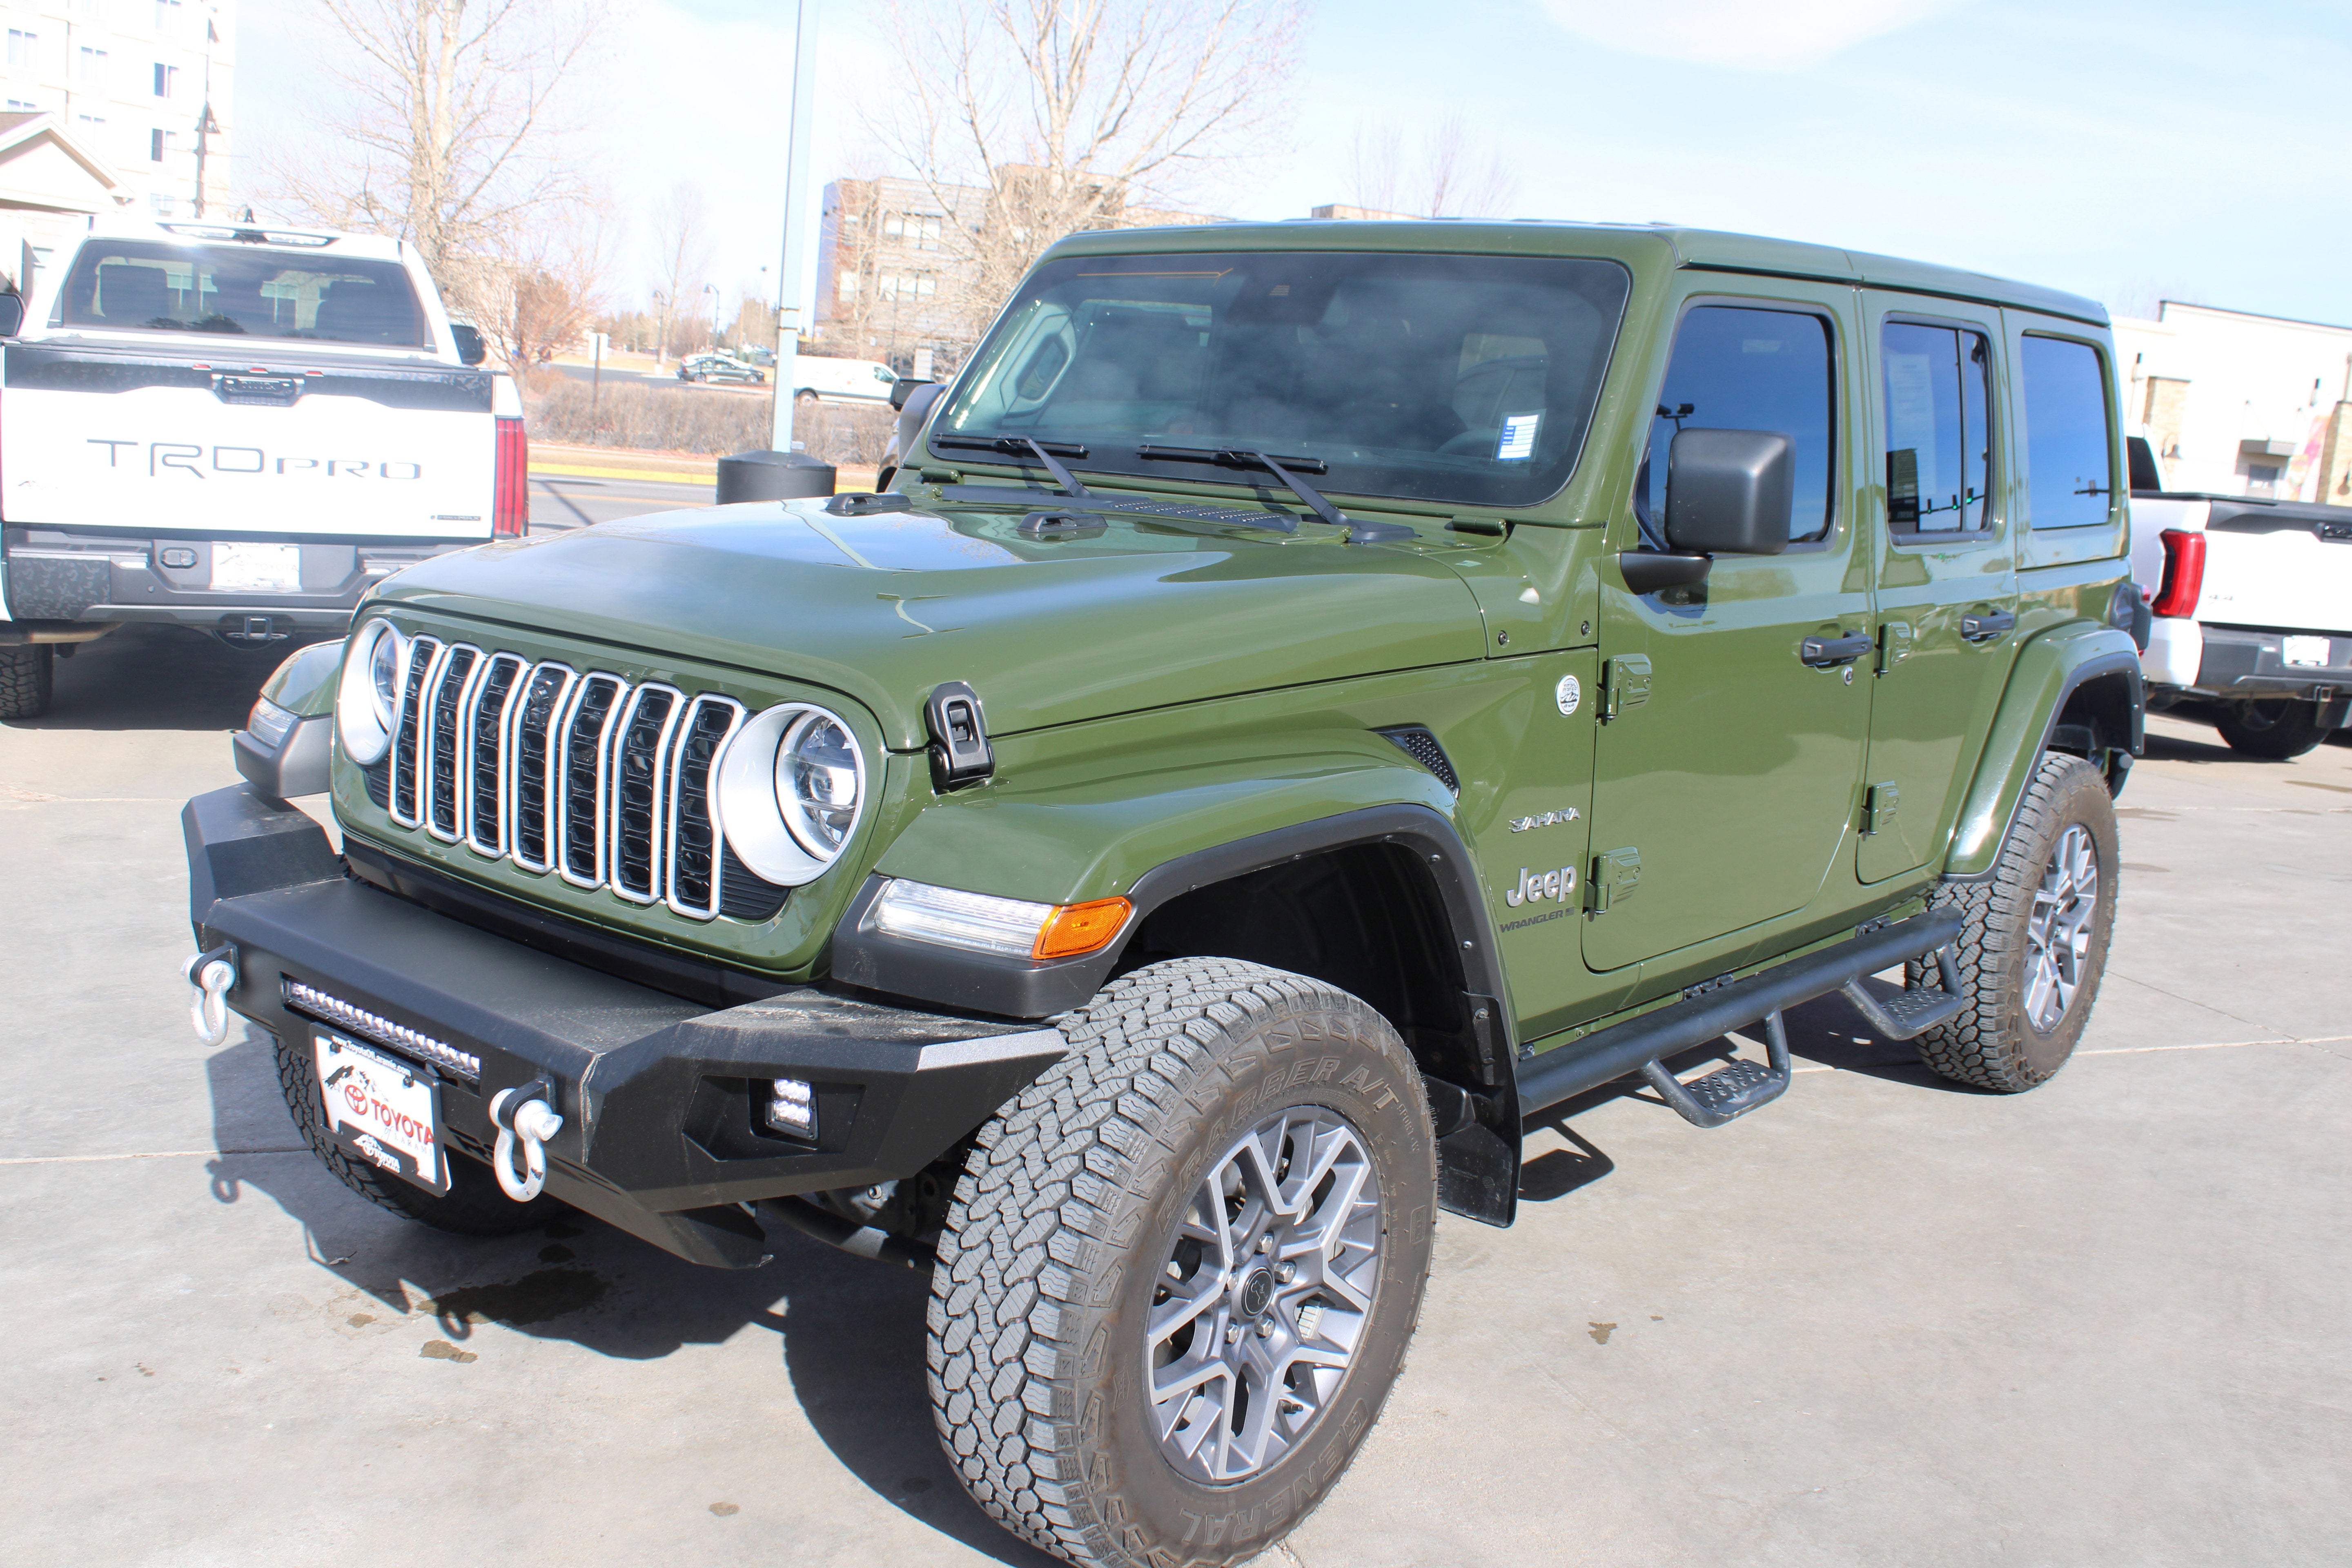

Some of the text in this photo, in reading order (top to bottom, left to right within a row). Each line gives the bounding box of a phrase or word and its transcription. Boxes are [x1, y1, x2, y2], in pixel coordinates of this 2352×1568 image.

[87, 439, 421, 479] TRD PRO
[1508, 807, 1581, 833] SAHARA
[1506, 865, 1577, 908] Jeep
[1499, 910, 1564, 933] WRANGLER
[371, 1098, 434, 1145] TOYOTA
[381, 1126, 433, 1156] of LARAMI
[1155, 1056, 1401, 1237] GRABBER A/T
[1179, 1398, 1369, 1546] GENERAL
